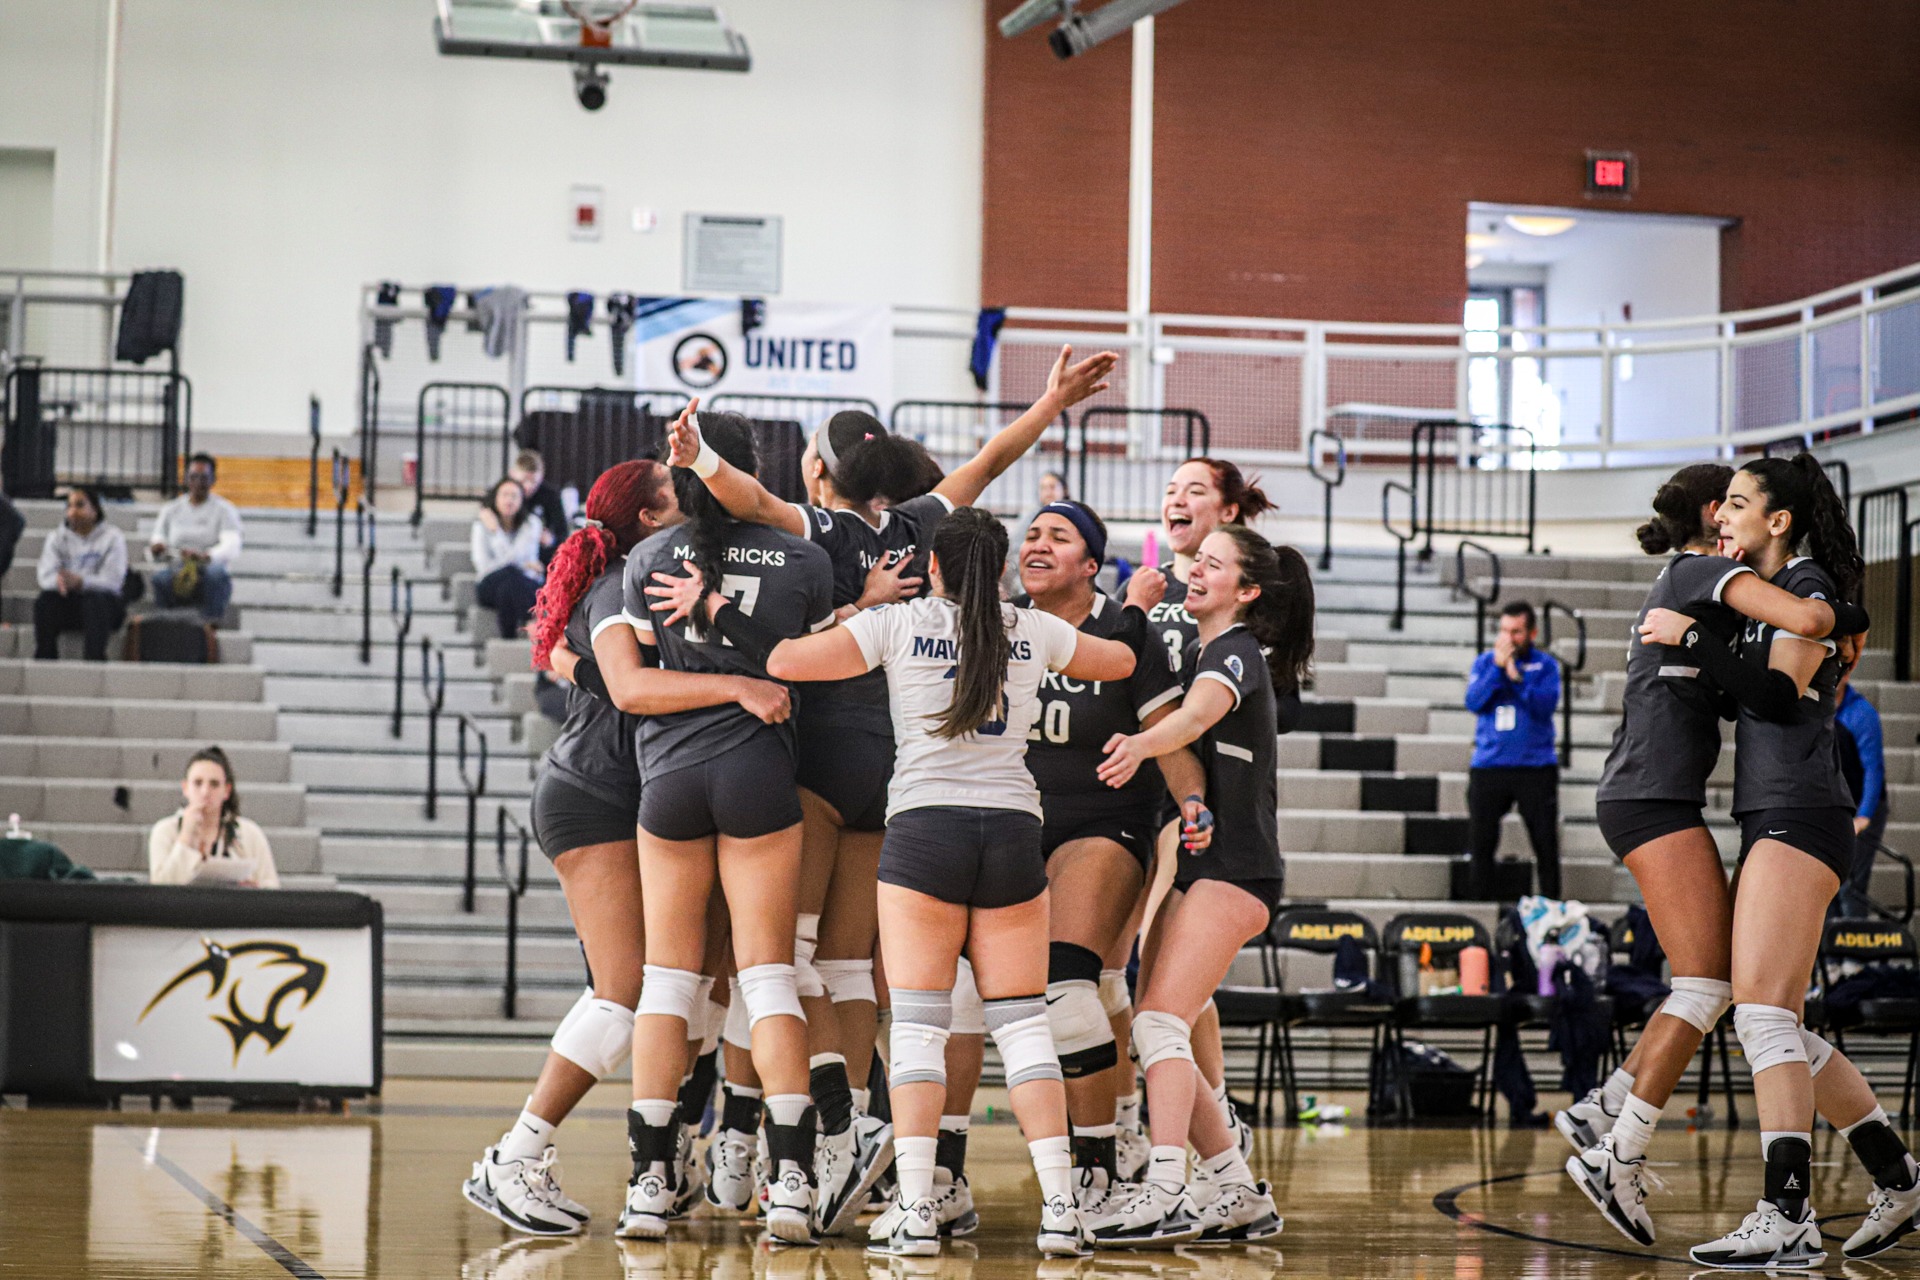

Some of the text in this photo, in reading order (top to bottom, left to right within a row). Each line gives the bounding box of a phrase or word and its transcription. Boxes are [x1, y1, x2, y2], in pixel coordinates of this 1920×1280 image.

[744, 335, 857, 372] UNITED
[1147, 602, 1198, 625] ERC
[1289, 923, 1364, 941] ADELPHI
[1401, 925, 1475, 942] ADELPHI
[1834, 931, 1903, 948] ADELPHI
